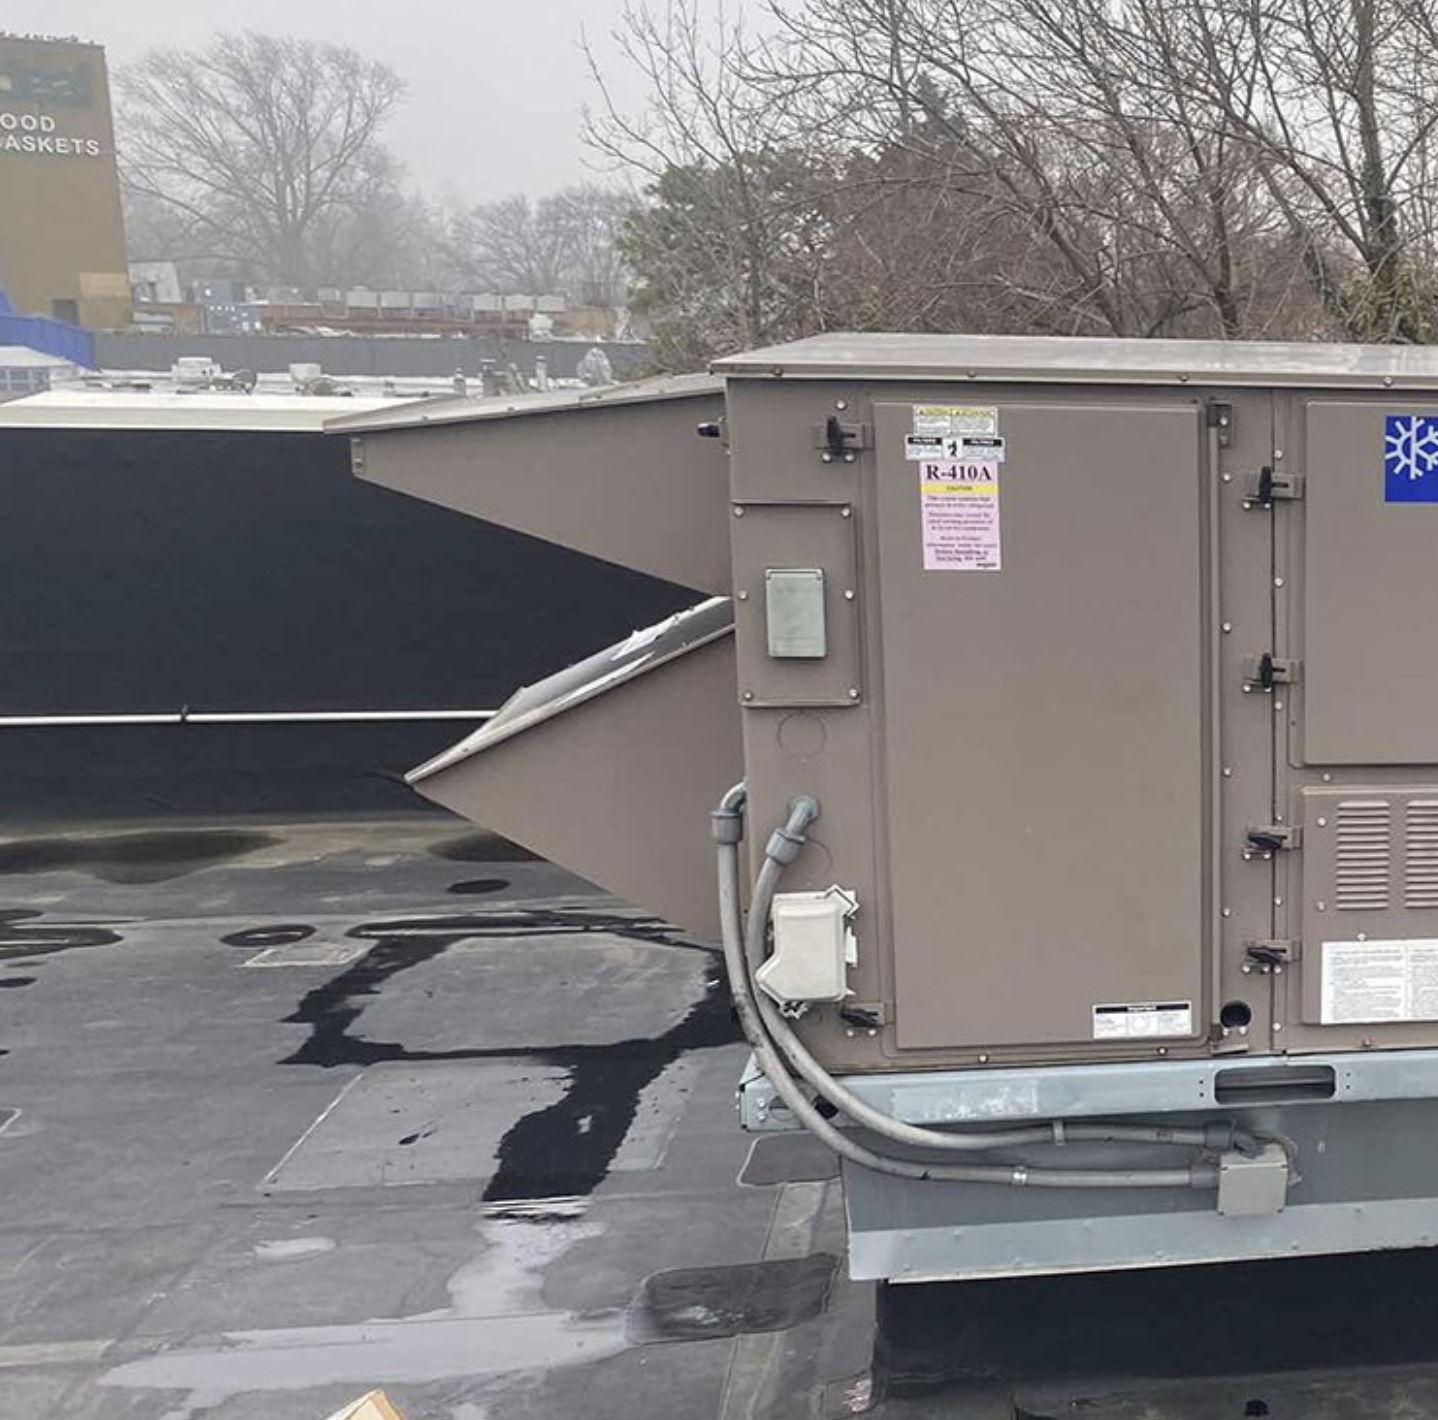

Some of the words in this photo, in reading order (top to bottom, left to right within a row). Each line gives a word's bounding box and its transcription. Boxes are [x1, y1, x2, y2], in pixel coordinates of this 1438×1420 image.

[0, 113, 55, 132] OOD
[0, 134, 100, 156] ASKETS
[926, 464, 992, 481] R-410A
